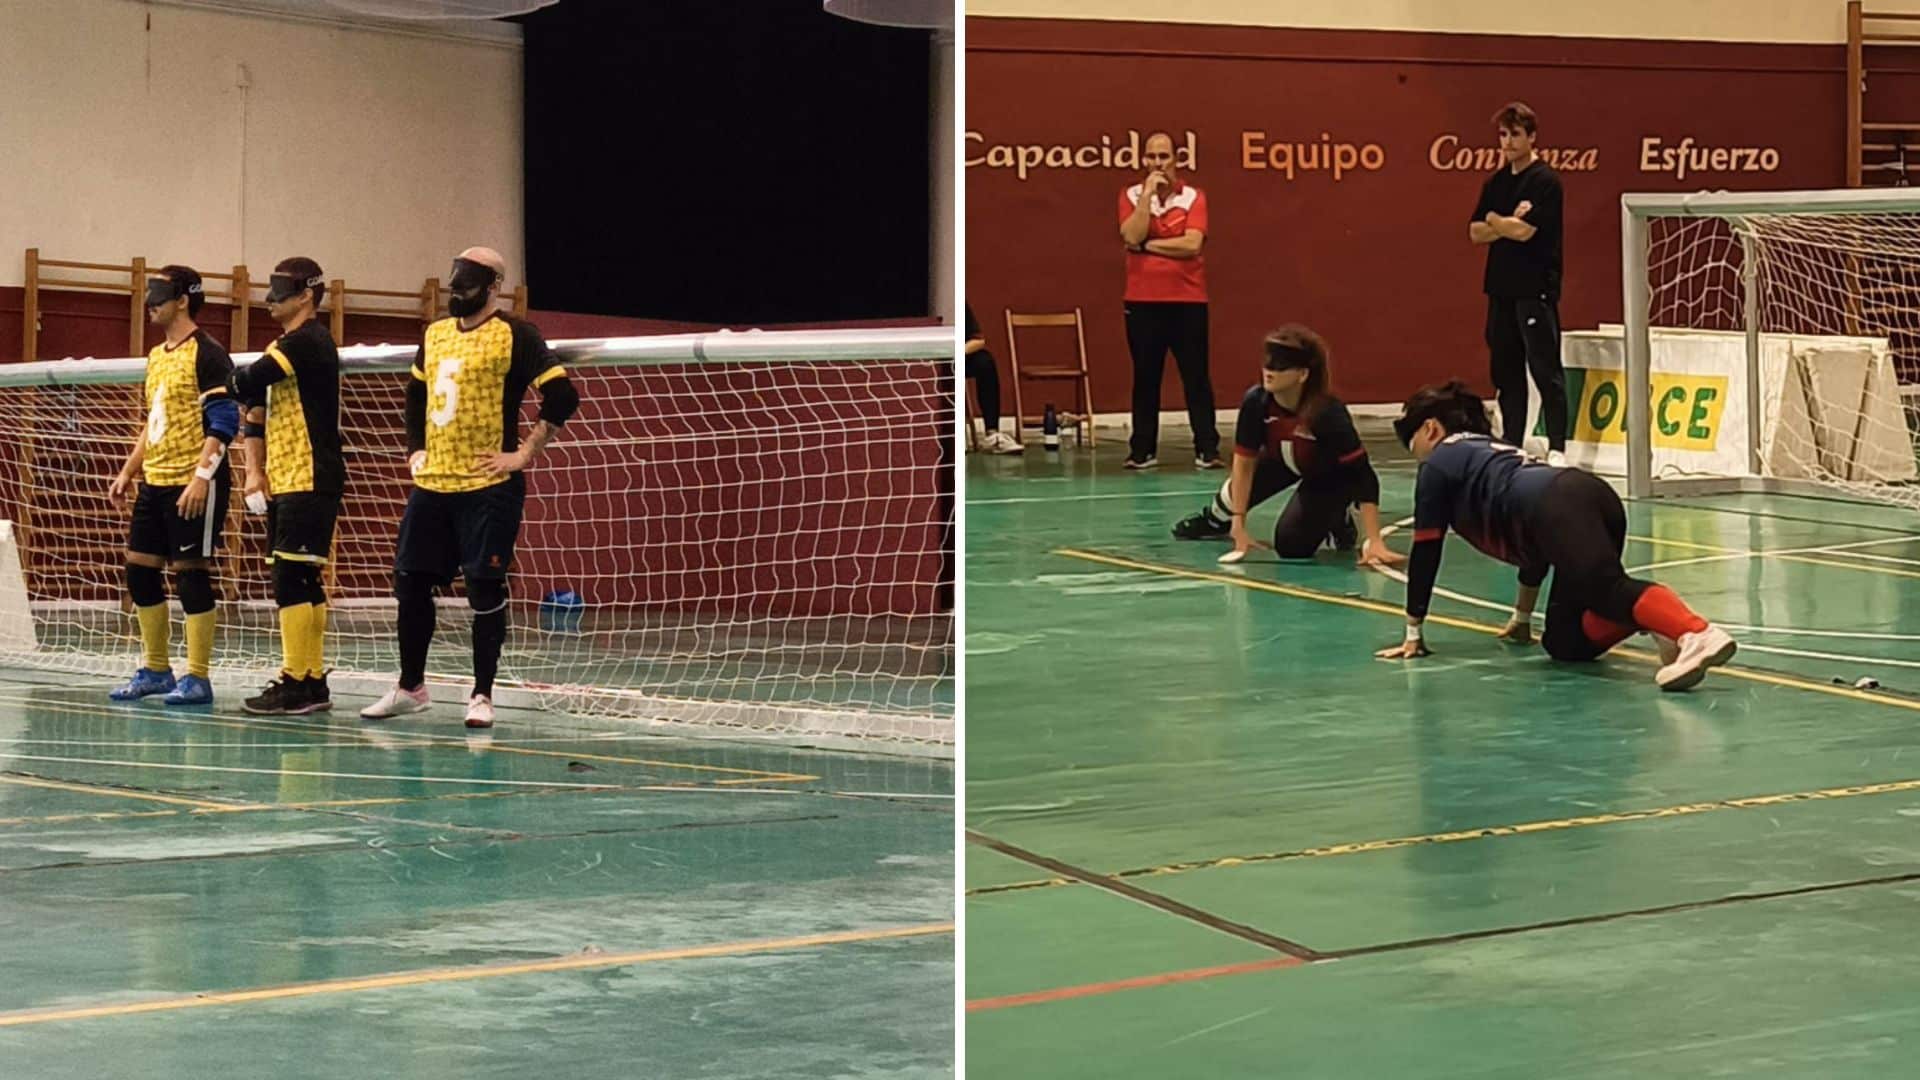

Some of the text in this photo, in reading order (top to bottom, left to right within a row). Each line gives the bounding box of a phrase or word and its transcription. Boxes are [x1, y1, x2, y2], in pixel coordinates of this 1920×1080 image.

[965, 130, 1196, 180] Capacidd
[1242, 131, 1385, 181] Equipo
[1429, 135, 1599, 171] Connza
[1640, 137, 1780, 180] Esfuerzo
[430, 358, 464, 427] 5
[1589, 381, 1718, 440] OCE
